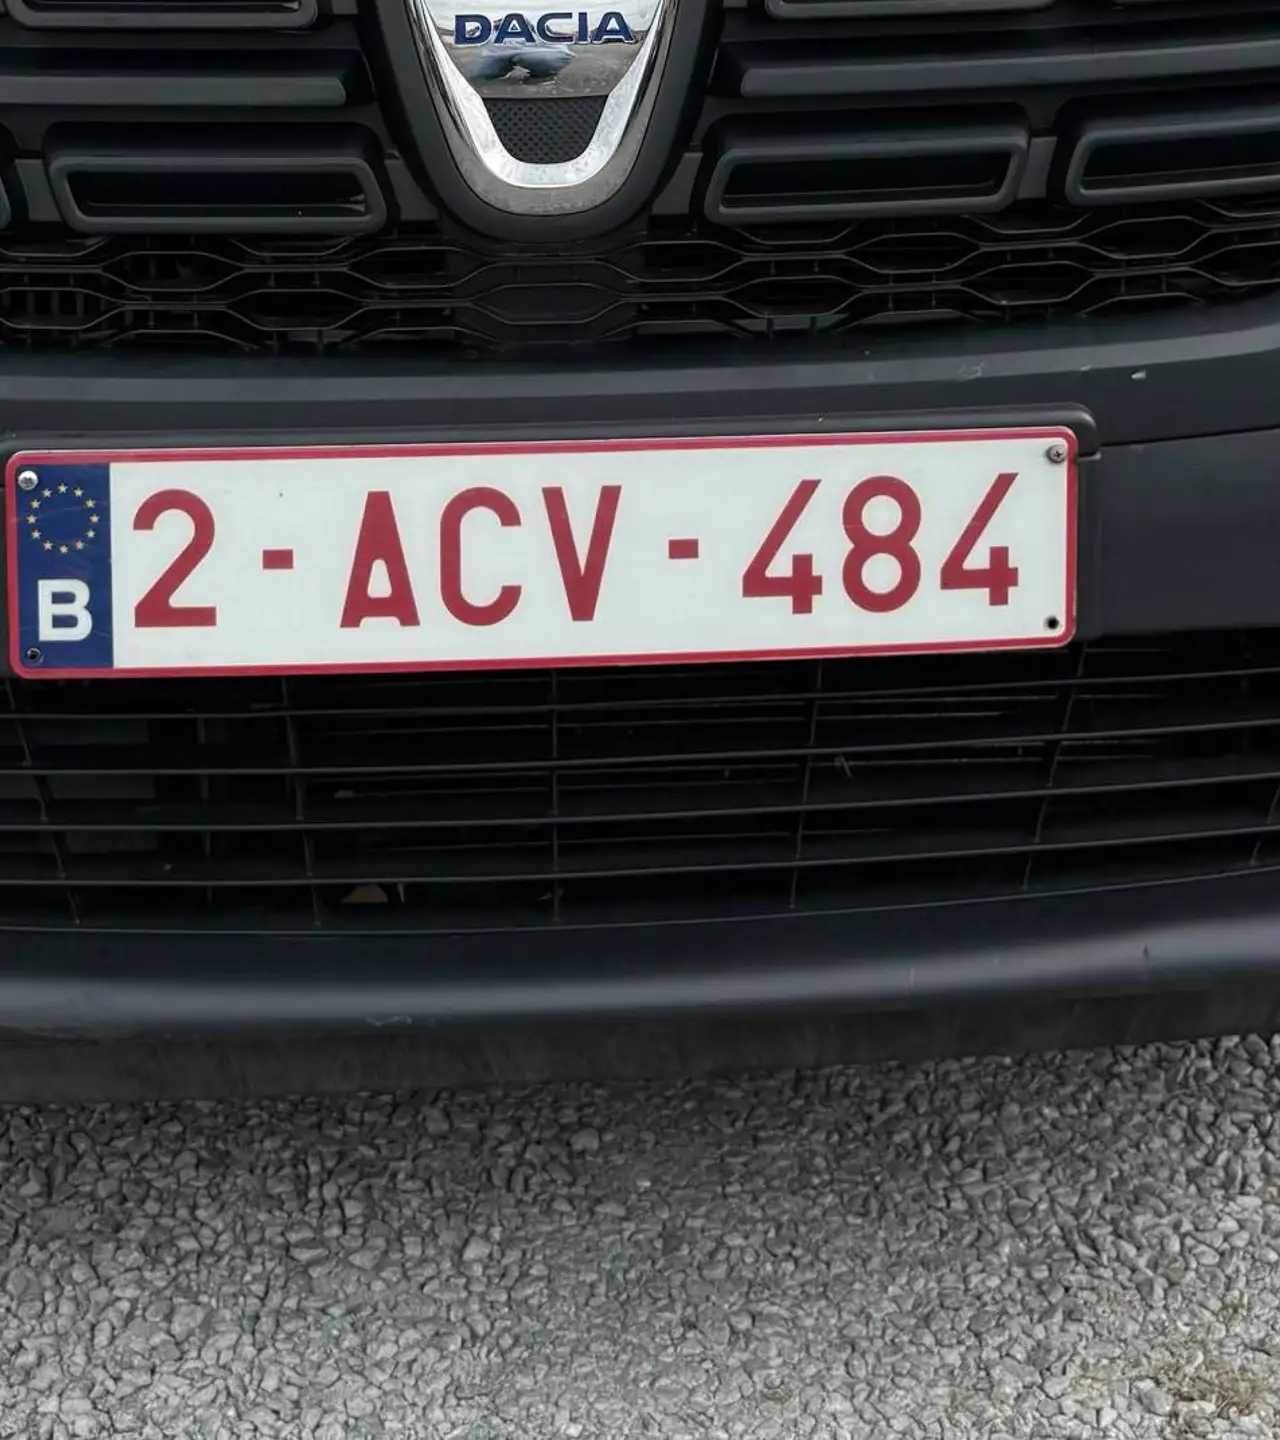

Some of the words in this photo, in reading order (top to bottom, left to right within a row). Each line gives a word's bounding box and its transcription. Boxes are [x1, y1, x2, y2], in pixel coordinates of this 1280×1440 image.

[453, 11, 635, 45] DACIA
[132, 471, 1019, 628] 2-ACV-484
[37, 578, 93, 642] B
